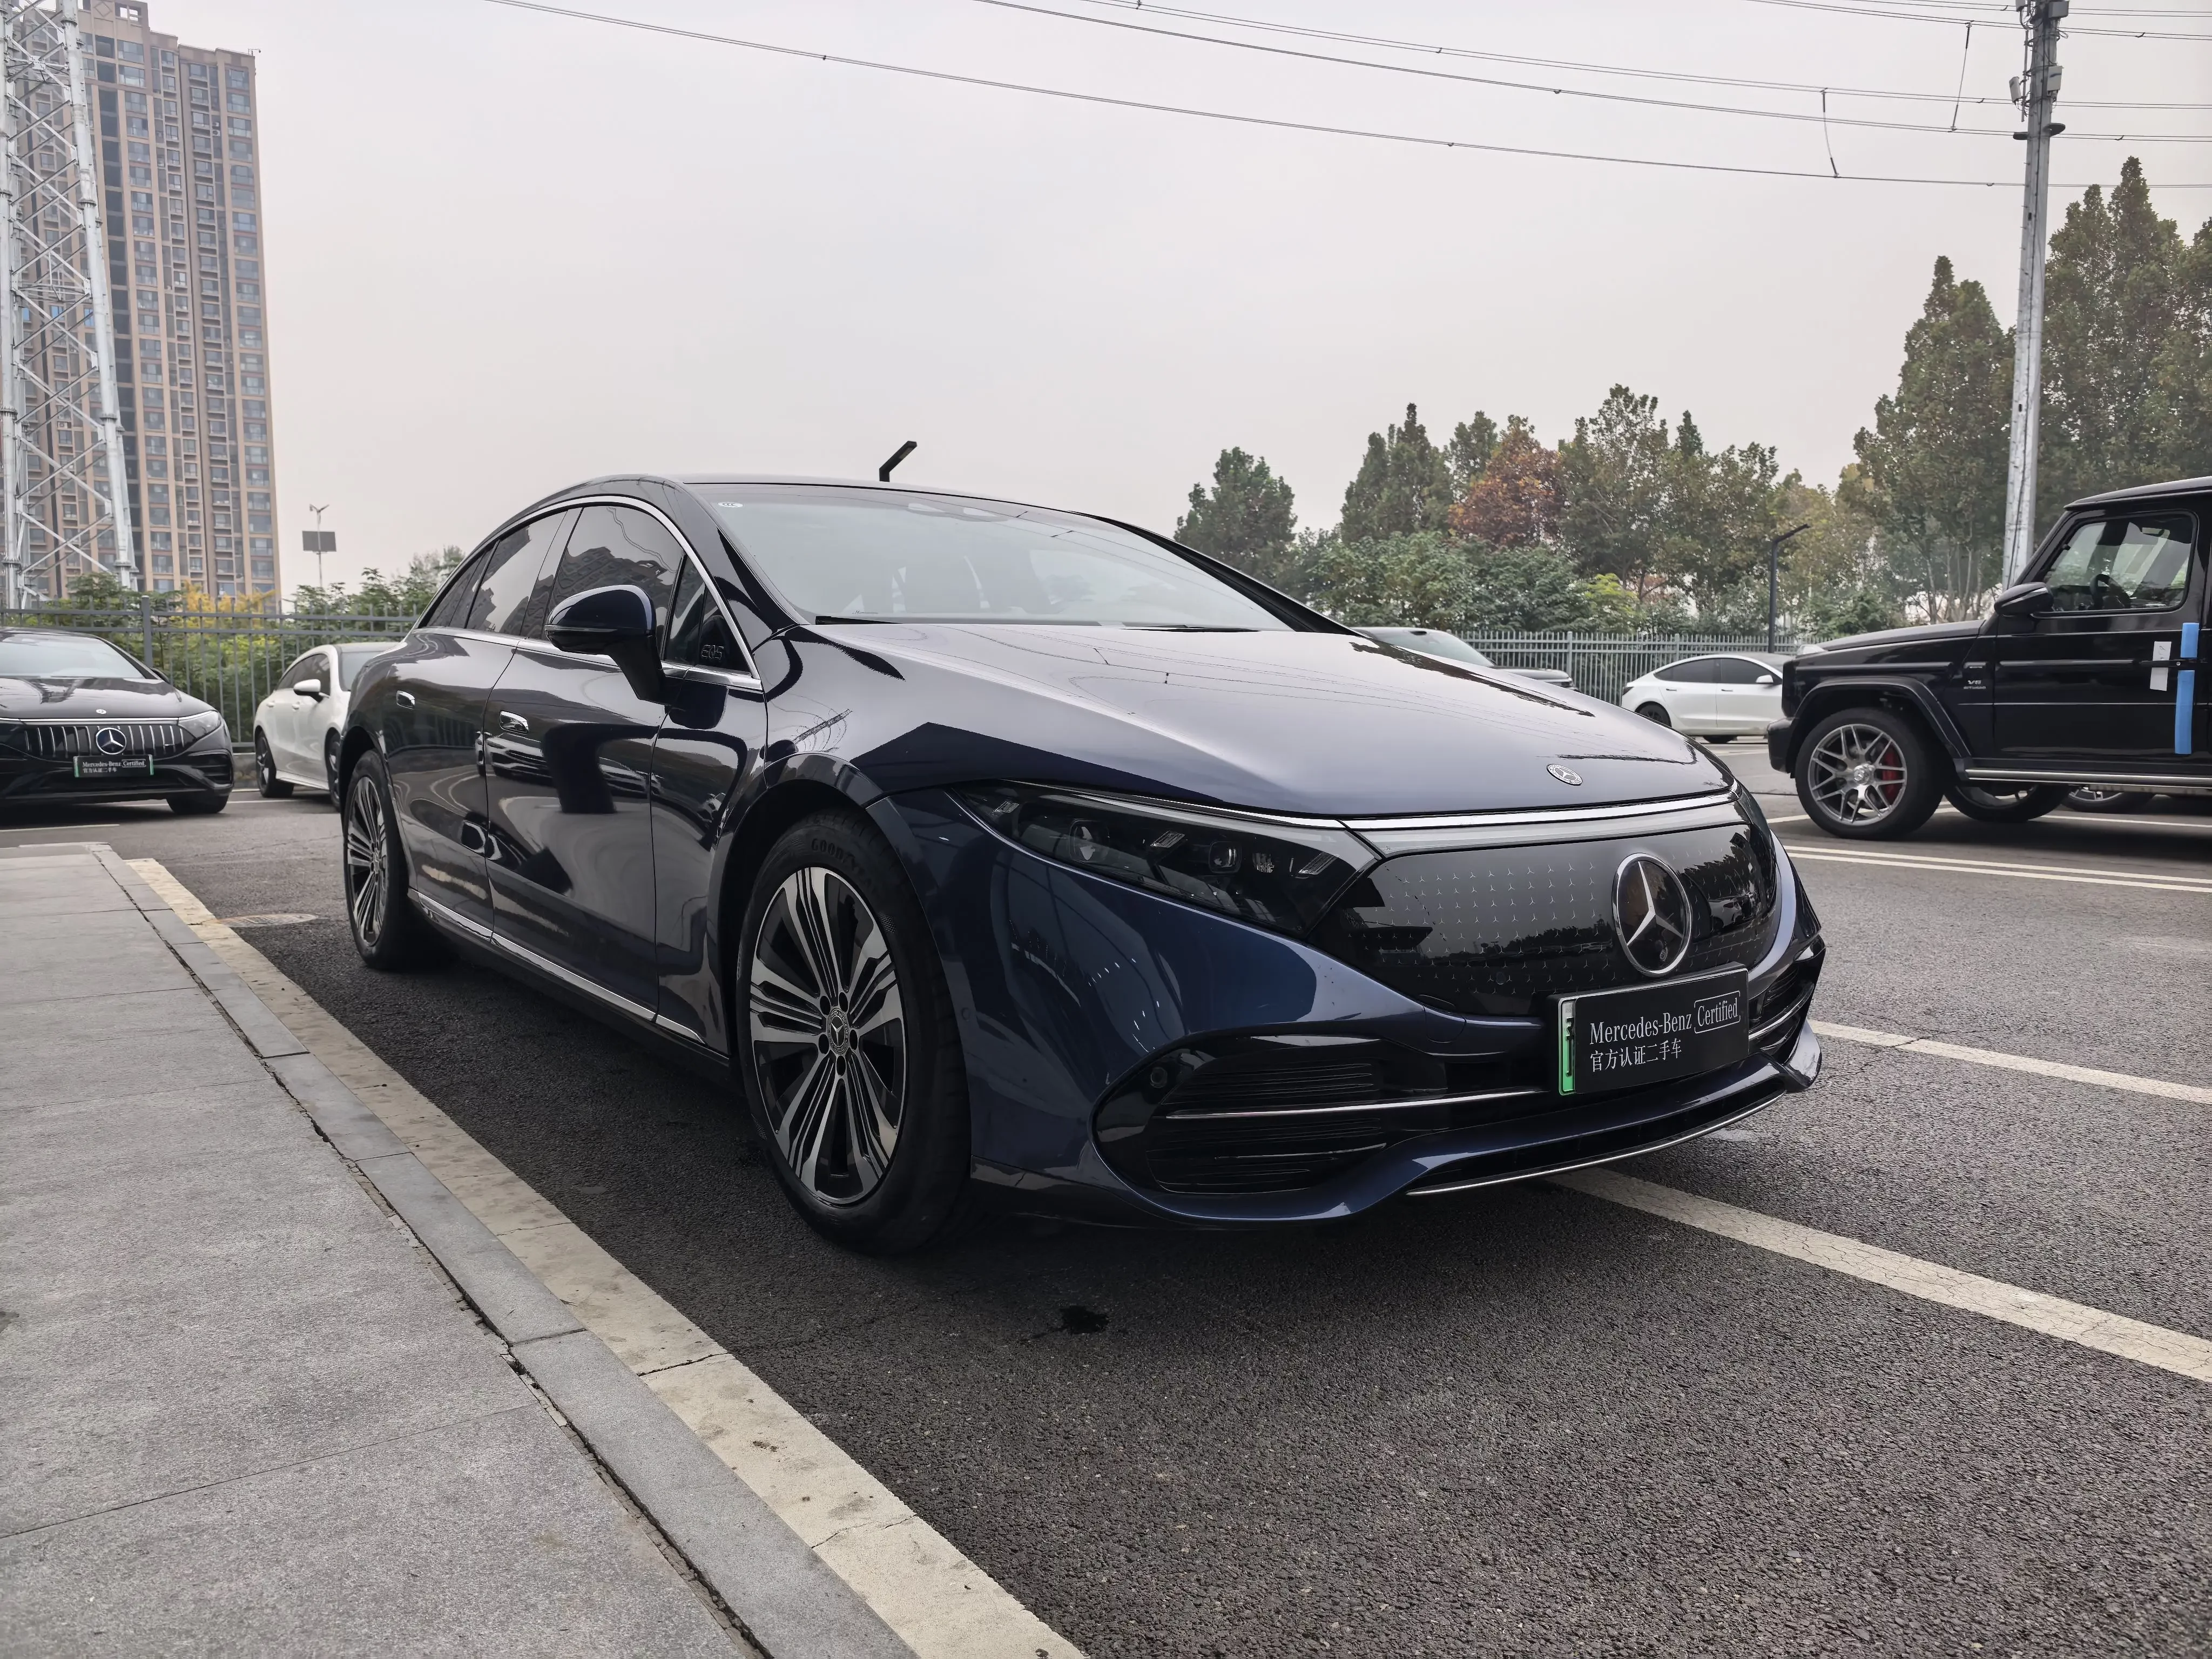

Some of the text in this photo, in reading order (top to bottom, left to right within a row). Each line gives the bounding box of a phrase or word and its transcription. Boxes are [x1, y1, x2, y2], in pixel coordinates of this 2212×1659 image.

[1590, 997, 1738, 1045] Mercedes-Benz Certified
[1590, 1037, 1682, 1073] 官方认证二手车
